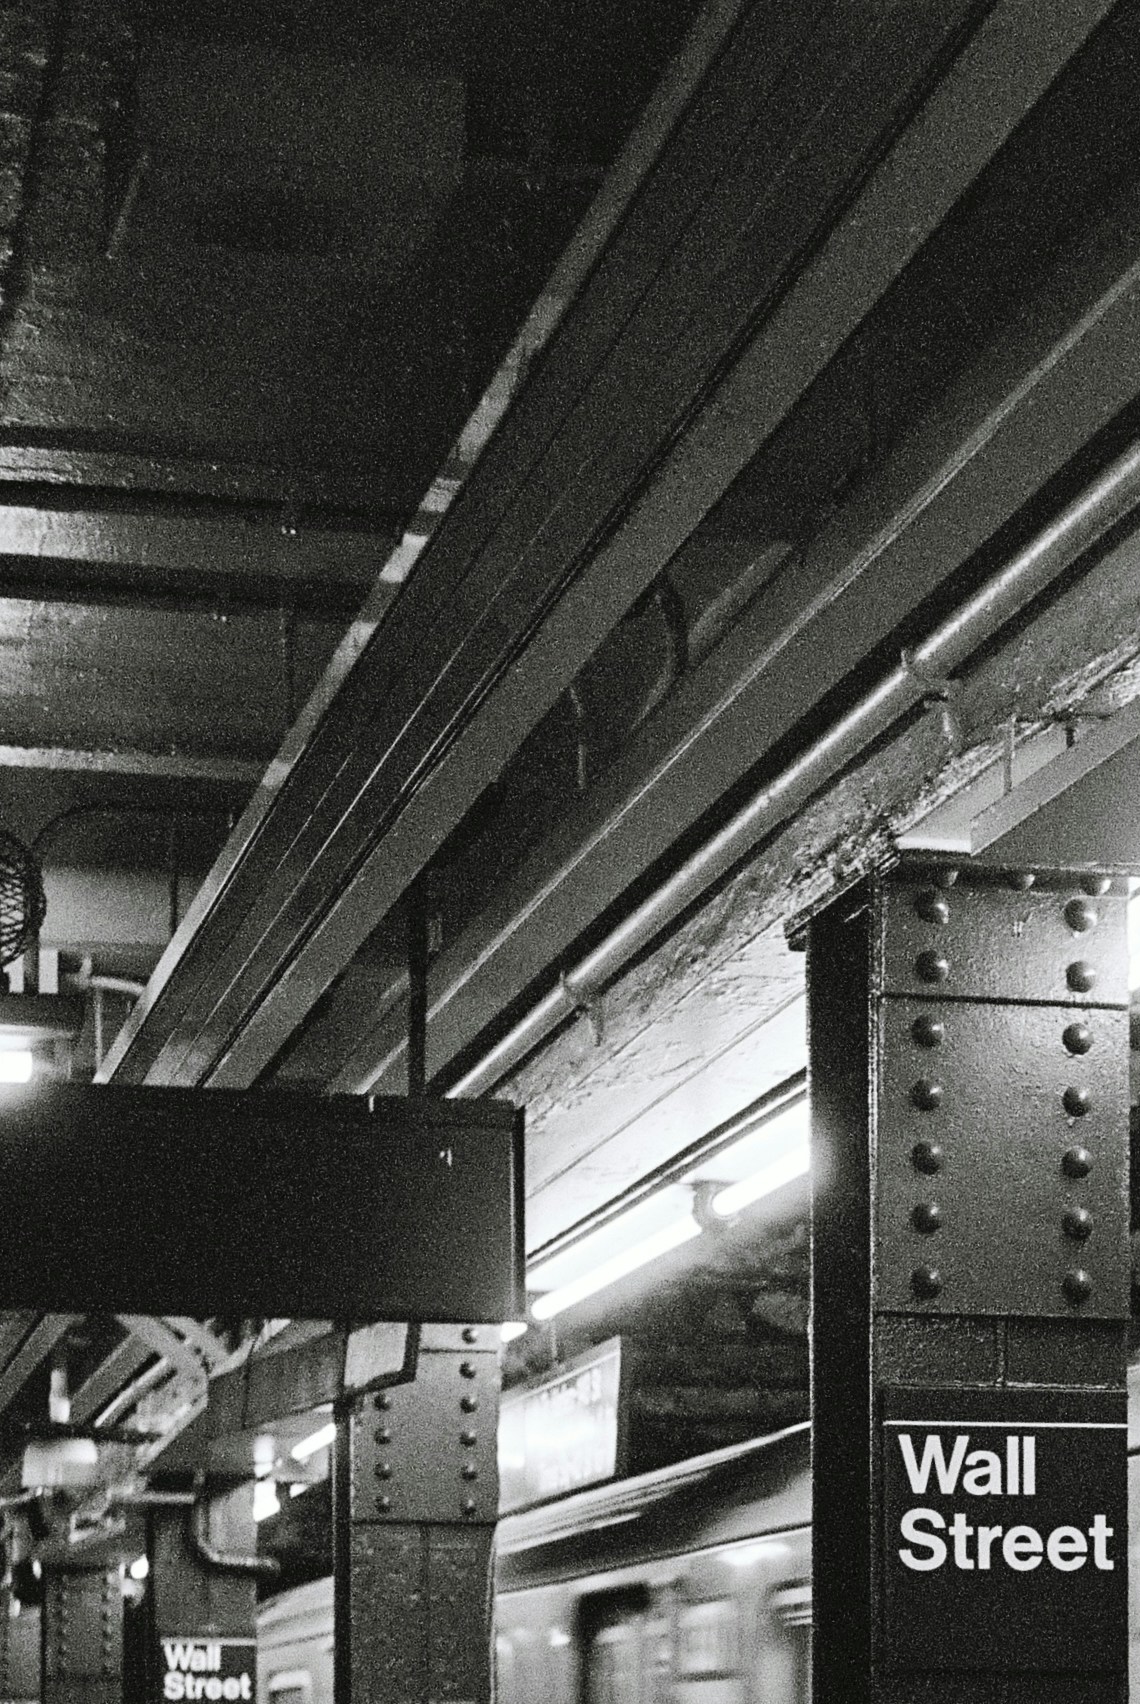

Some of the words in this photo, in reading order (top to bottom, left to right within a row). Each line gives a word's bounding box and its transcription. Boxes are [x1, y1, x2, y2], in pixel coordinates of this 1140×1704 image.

[897, 1434, 1037, 1496] Wall
[898, 1507, 1115, 1572] Street
[163, 1641, 221, 1672] Wall
[163, 1671, 252, 1701] Street
